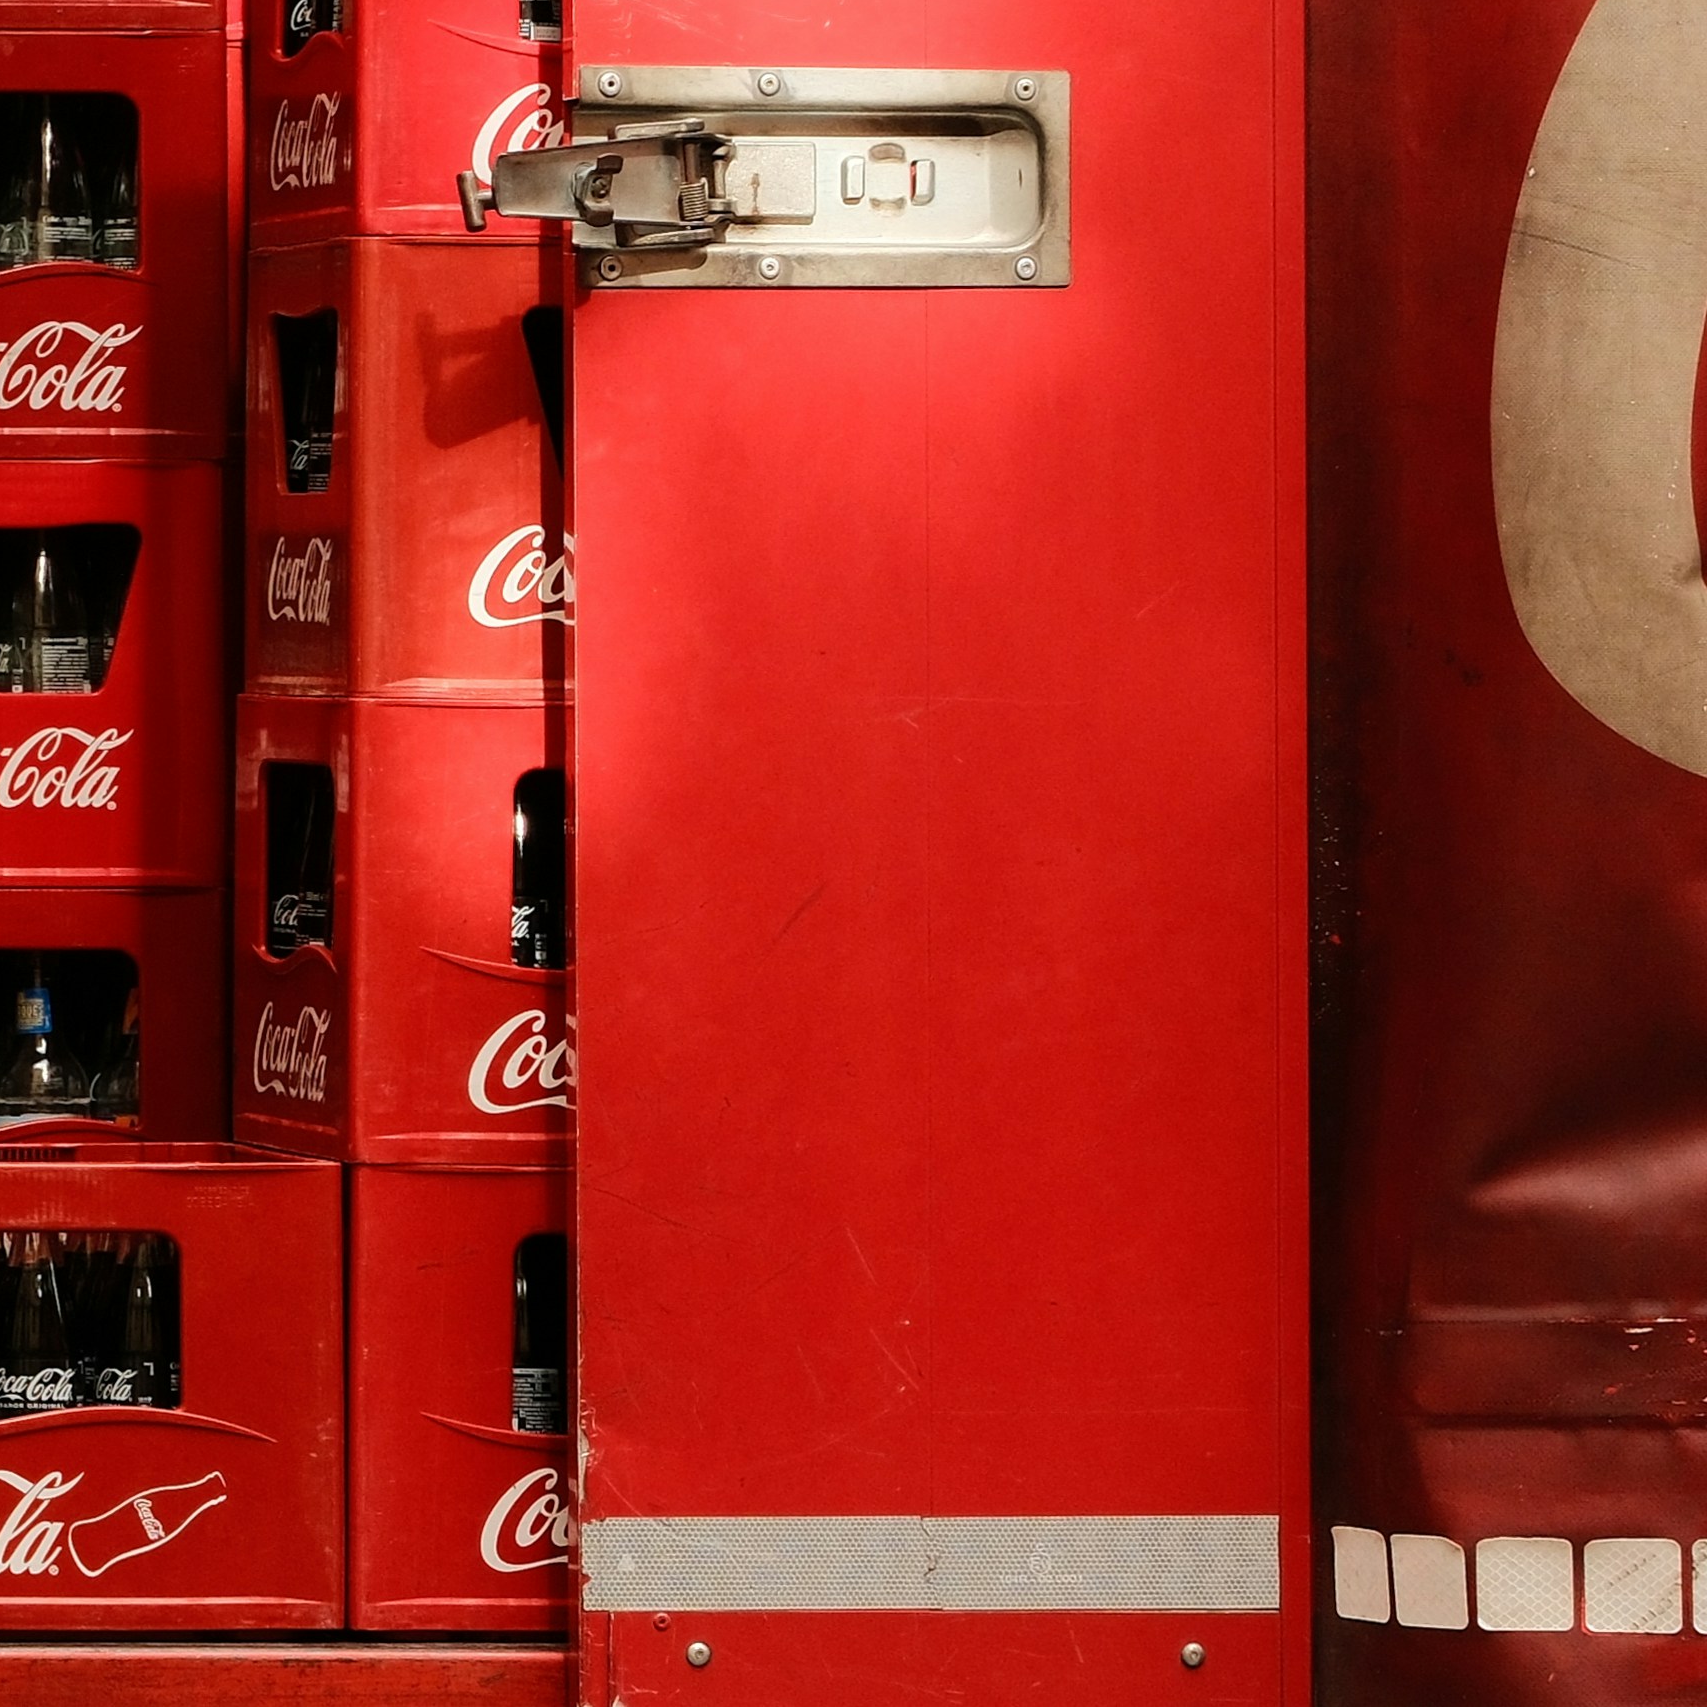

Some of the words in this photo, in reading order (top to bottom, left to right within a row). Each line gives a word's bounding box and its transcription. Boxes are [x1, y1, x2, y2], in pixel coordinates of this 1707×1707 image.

[271, 93, 339, 190] Coca-Cola
[268, 537, 331, 623] Coca-Cola
[254, 1002, 329, 1101] Coca-Cola
